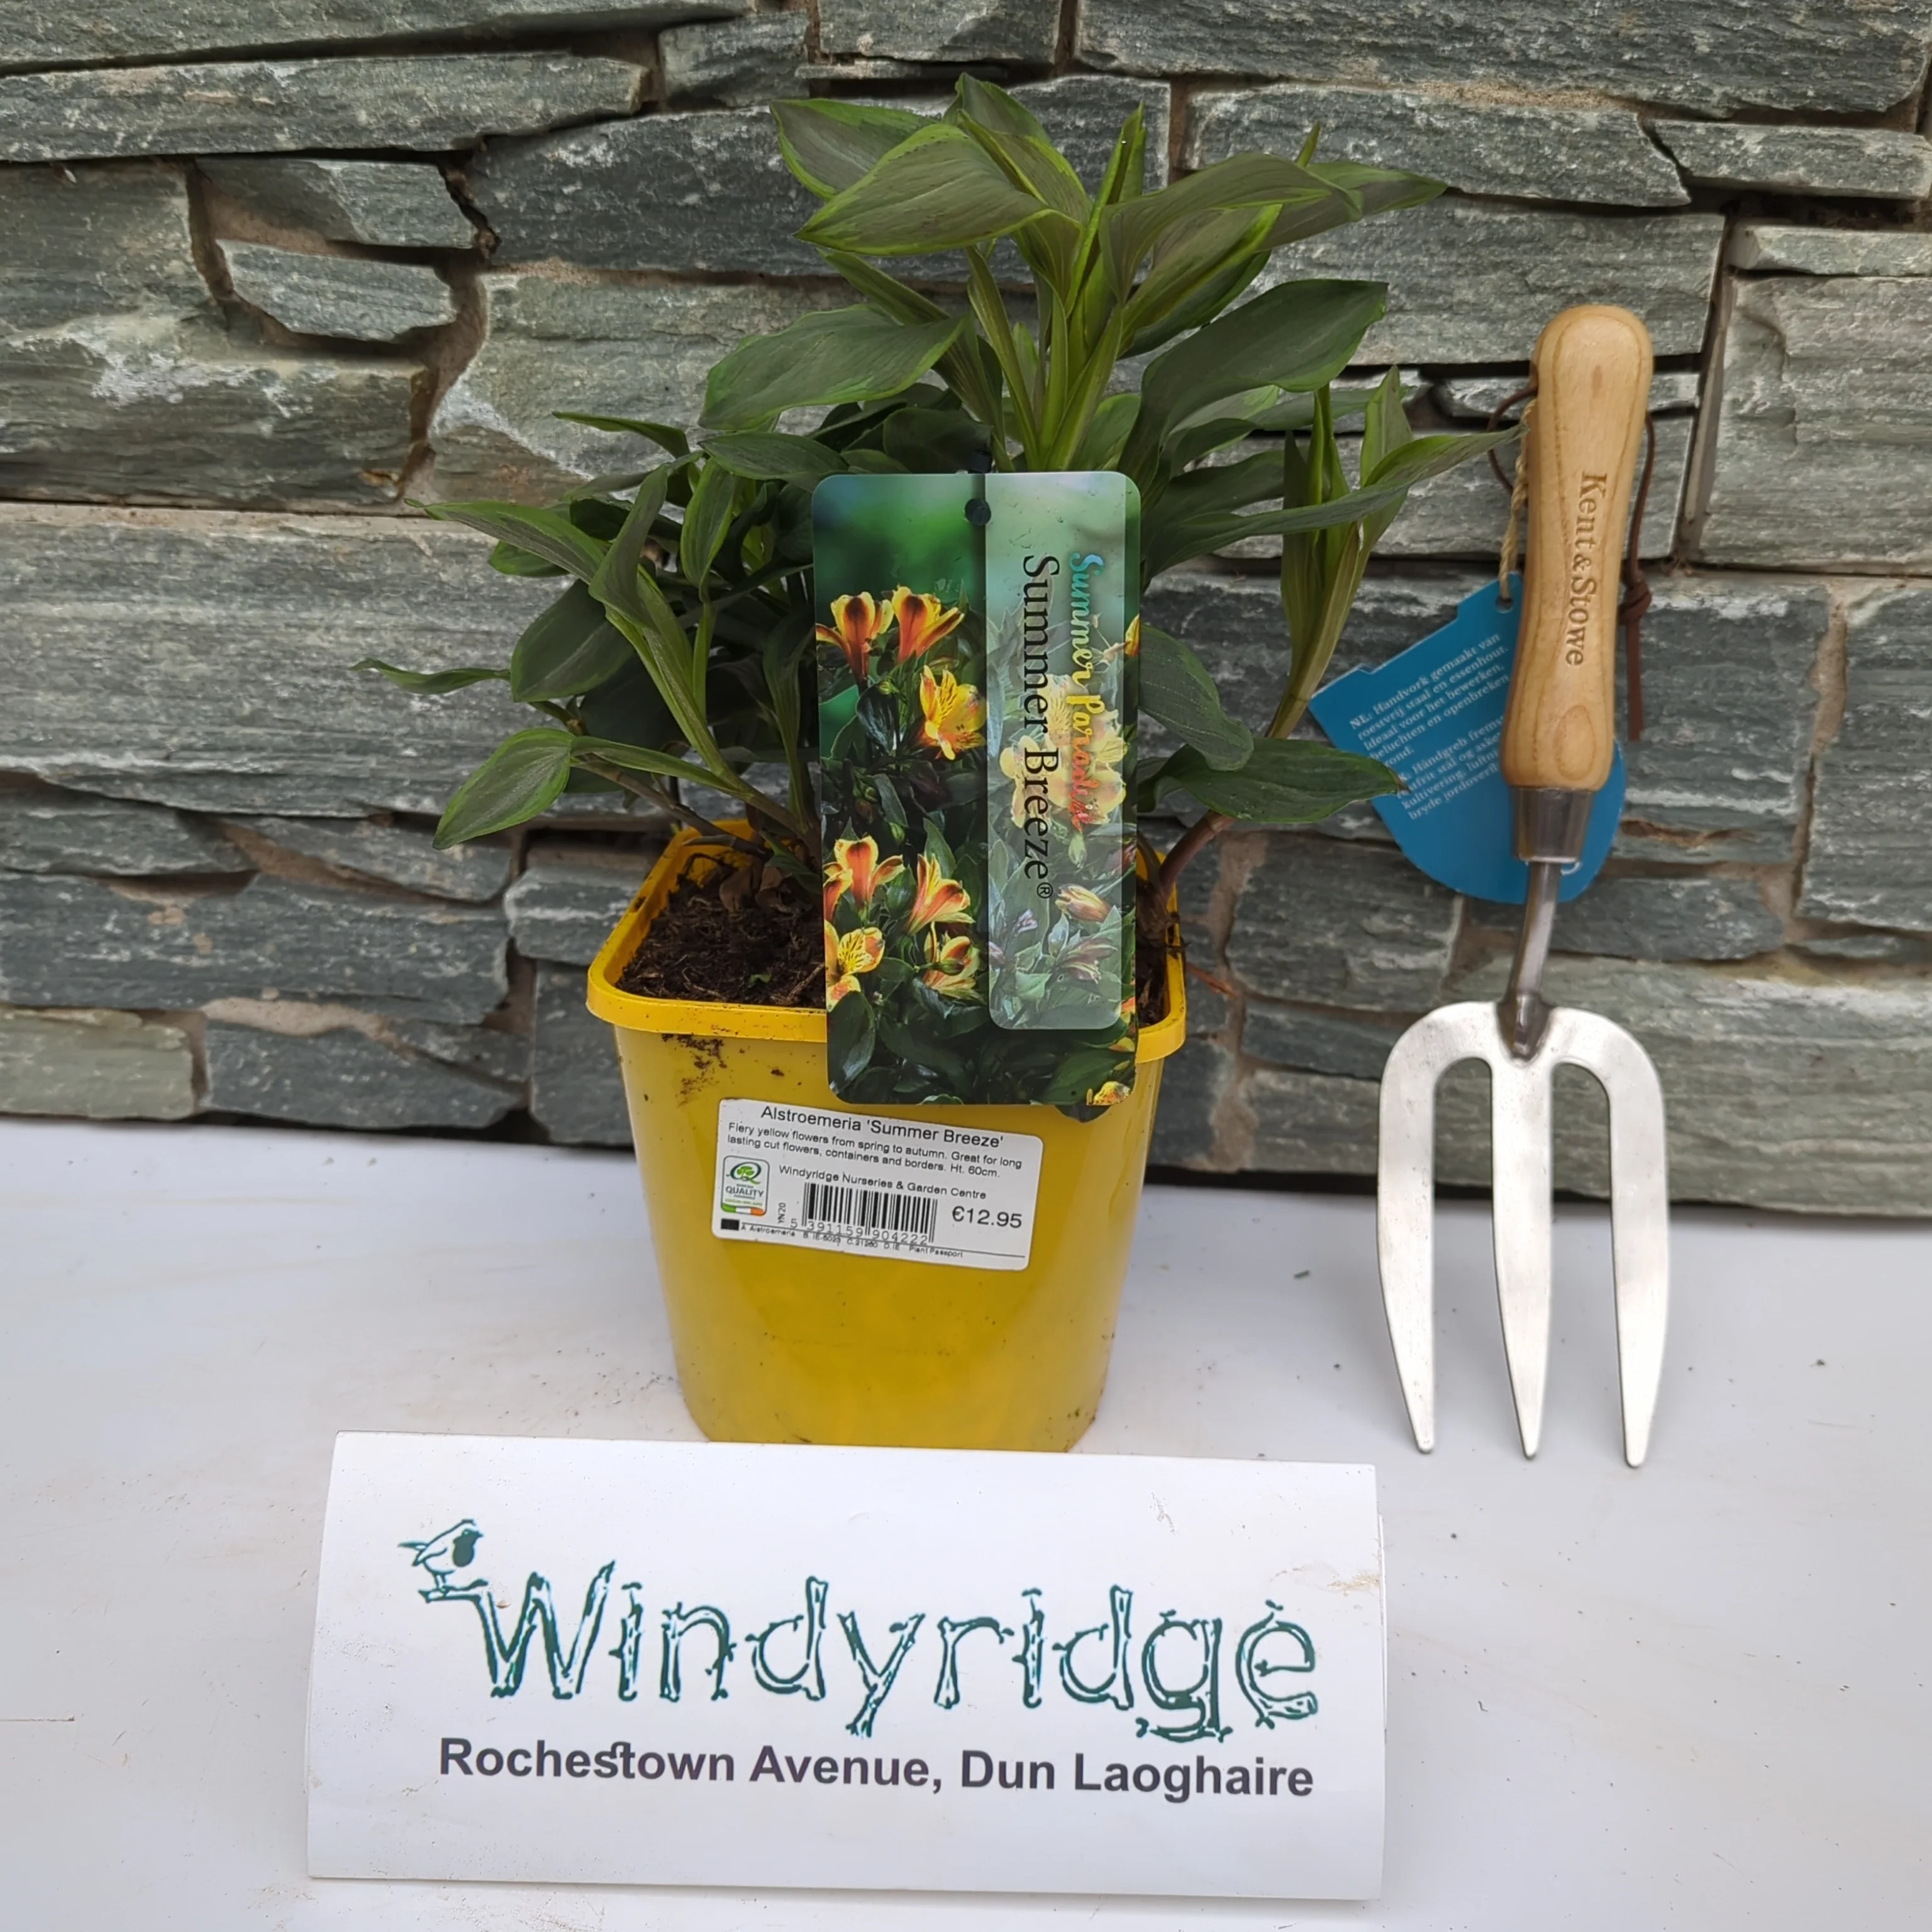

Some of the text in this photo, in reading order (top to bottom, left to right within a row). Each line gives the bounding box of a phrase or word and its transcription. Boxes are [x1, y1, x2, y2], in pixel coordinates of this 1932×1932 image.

[1069, 551, 1105, 687] Summer
[1022, 555, 1060, 735] Summer
[1373, 677, 1430, 715] Handvork
[1430, 647, 1478, 682] gemaakt
[1479, 635, 1501, 650] van
[1358, 708, 1406, 741] roestvrij
[1406, 689, 1432, 709] staal
[1433, 682, 1448, 694] en
[1399, 710, 1425, 729] voor
[1425, 697, 1446, 713] het
[1427, 715, 1443, 727] en
[1459, 750, 1475, 762] og
[1408, 797, 1443, 820] bryde
[728, 1121, 1022, 1170] Fiery yellow flowers from spring to autumn. Great for long
[760, 1105, 1003, 1148] Alstroemeria 'Summer Breeze'
[727, 1134, 999, 1177] lasting cut flowers, containers and borders. Ht. 60cm.
[724, 1185, 764, 1197] QUALITY
[779, 1165, 986, 1199] Windyridge Nurseries & Garden Centre
[789, 1217, 799, 1229] 5
[871, 1228, 929, 1246] 904222
[951, 1205, 1022, 1228] €12.95
[415, 1560, 1319, 1743] Windyridge
[440, 1737, 1313, 1804] Rochestown Avenue, Dun Laoghaire
